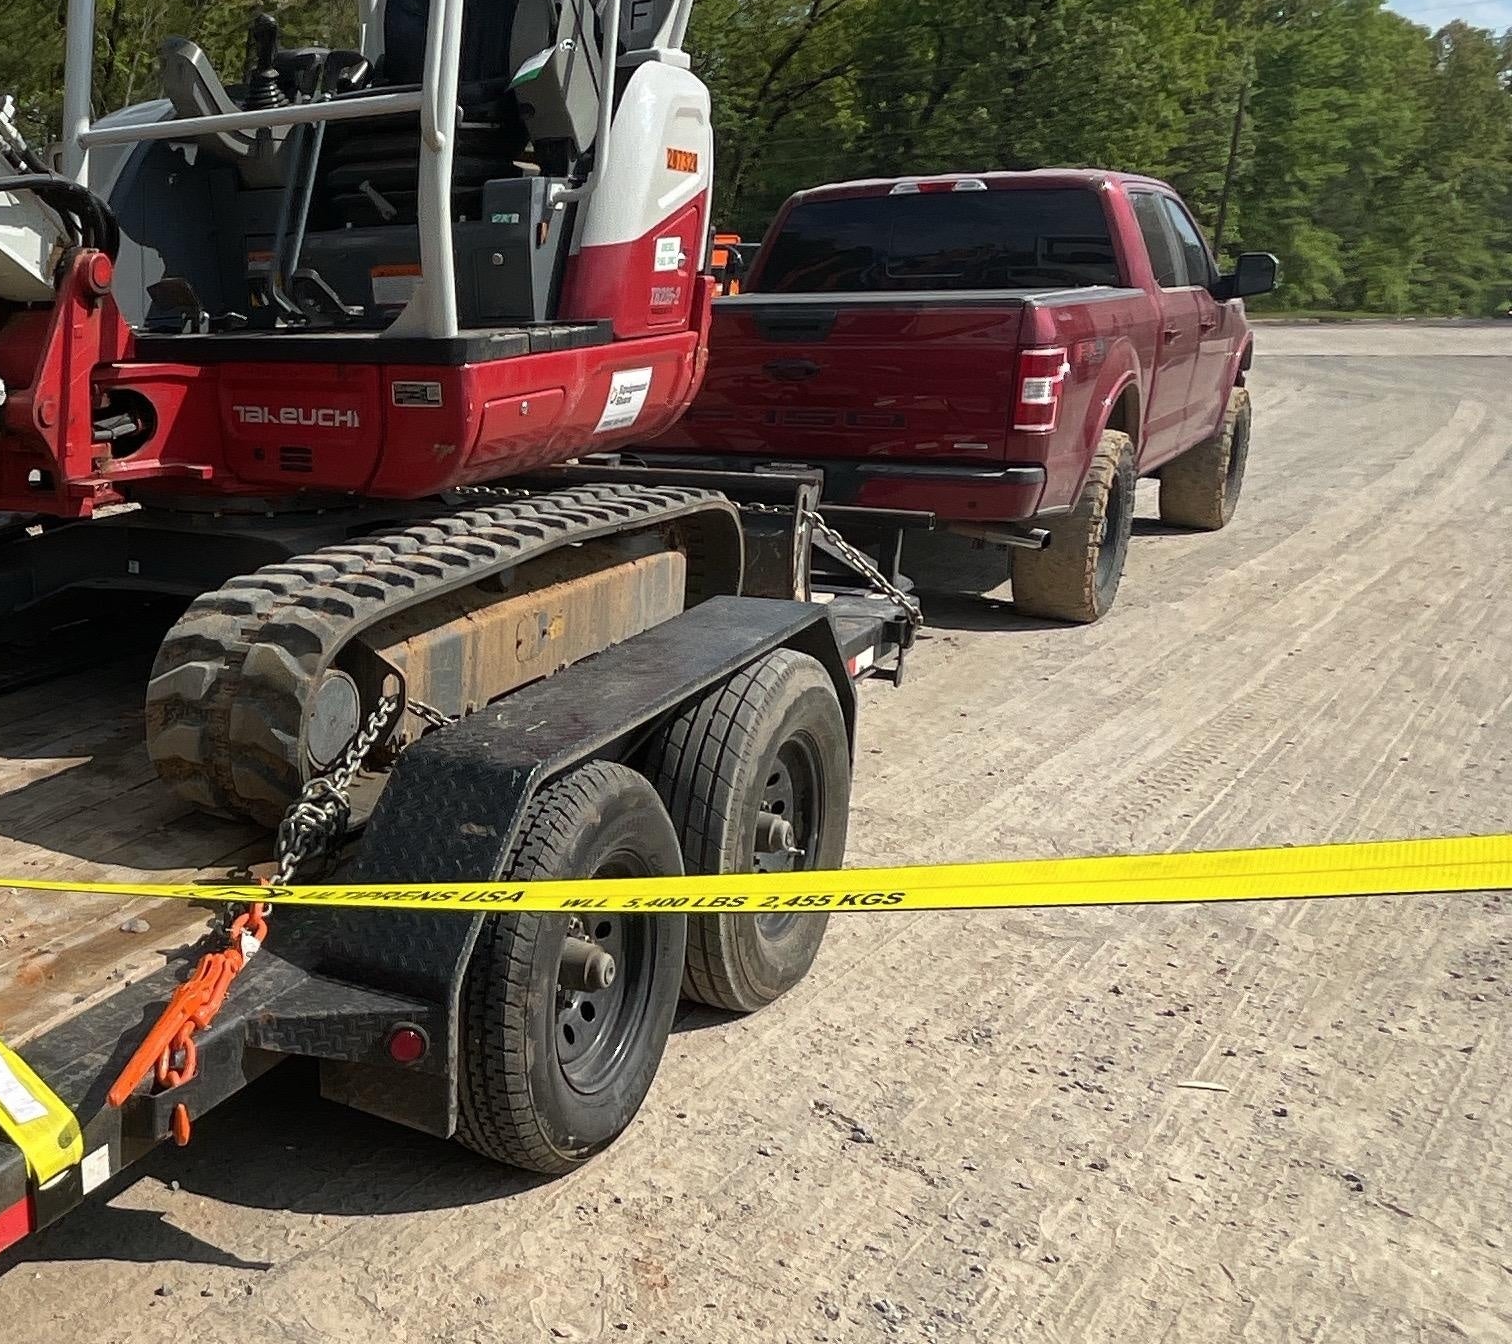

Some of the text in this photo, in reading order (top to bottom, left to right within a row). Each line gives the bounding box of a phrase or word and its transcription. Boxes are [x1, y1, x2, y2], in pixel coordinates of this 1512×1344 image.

[233, 405, 360, 428] TAKEUCHI
[459, 890, 525, 903] USA
[560, 897, 609, 908] WLL
[622, 896, 690, 910] 5,400
[691, 895, 749, 908] LBS
[758, 893, 834, 910] 2,455
[836, 891, 906, 907] KGS
